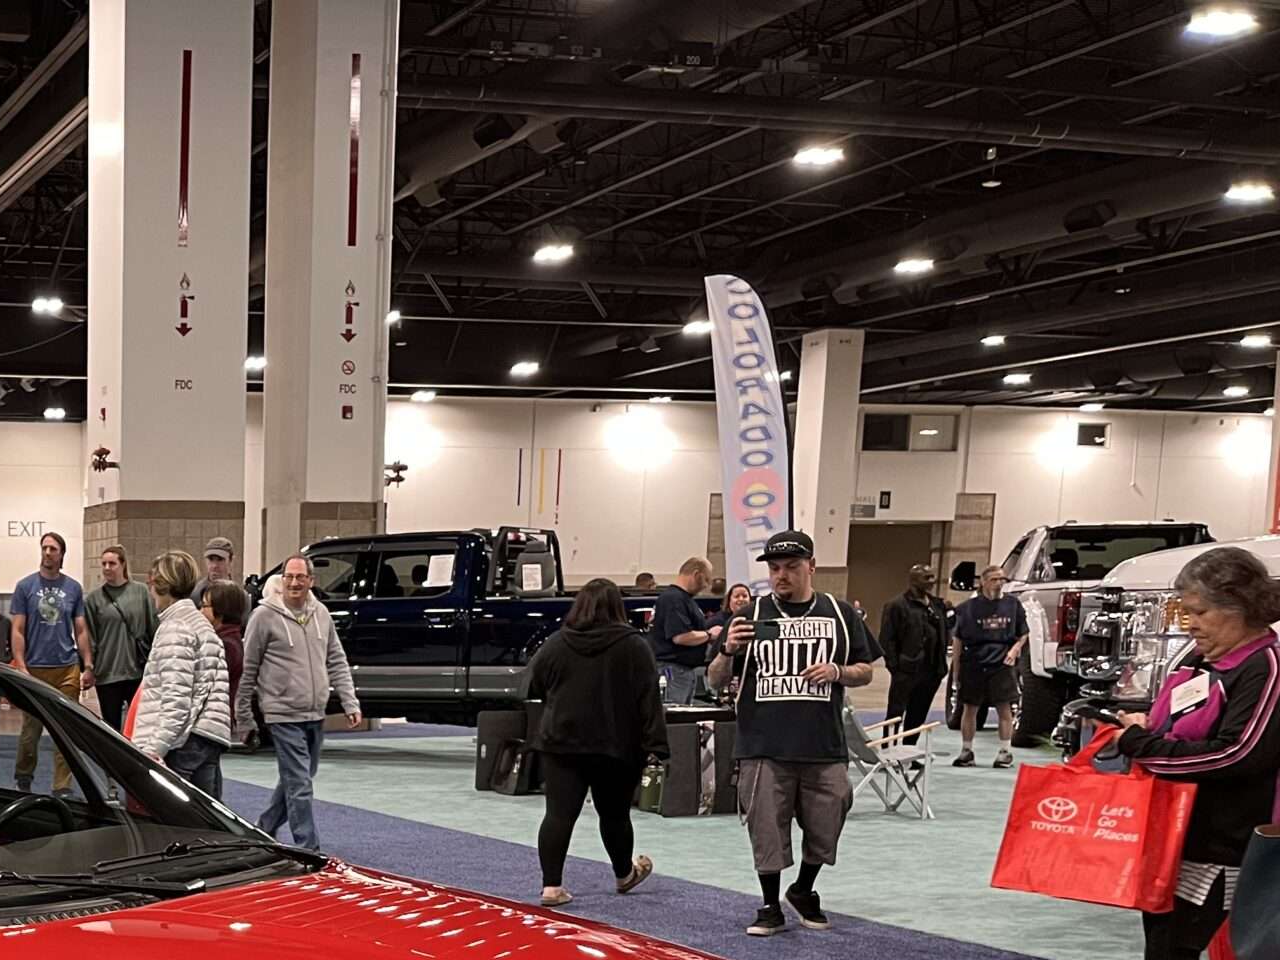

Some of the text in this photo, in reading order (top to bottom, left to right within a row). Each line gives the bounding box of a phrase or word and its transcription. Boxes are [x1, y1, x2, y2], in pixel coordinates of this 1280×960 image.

[175, 380, 193, 390] FDC
[339, 384, 357, 394] FDC
[7, 520, 48, 537] EXIT
[760, 639, 828, 677] OUTTA
[761, 678, 826, 696] DENVER
[1100, 805, 1134, 817] Let's
[1031, 821, 1075, 834] TOYOTA
[1097, 817, 1117, 828] Go
[1093, 829, 1139, 842] Places
